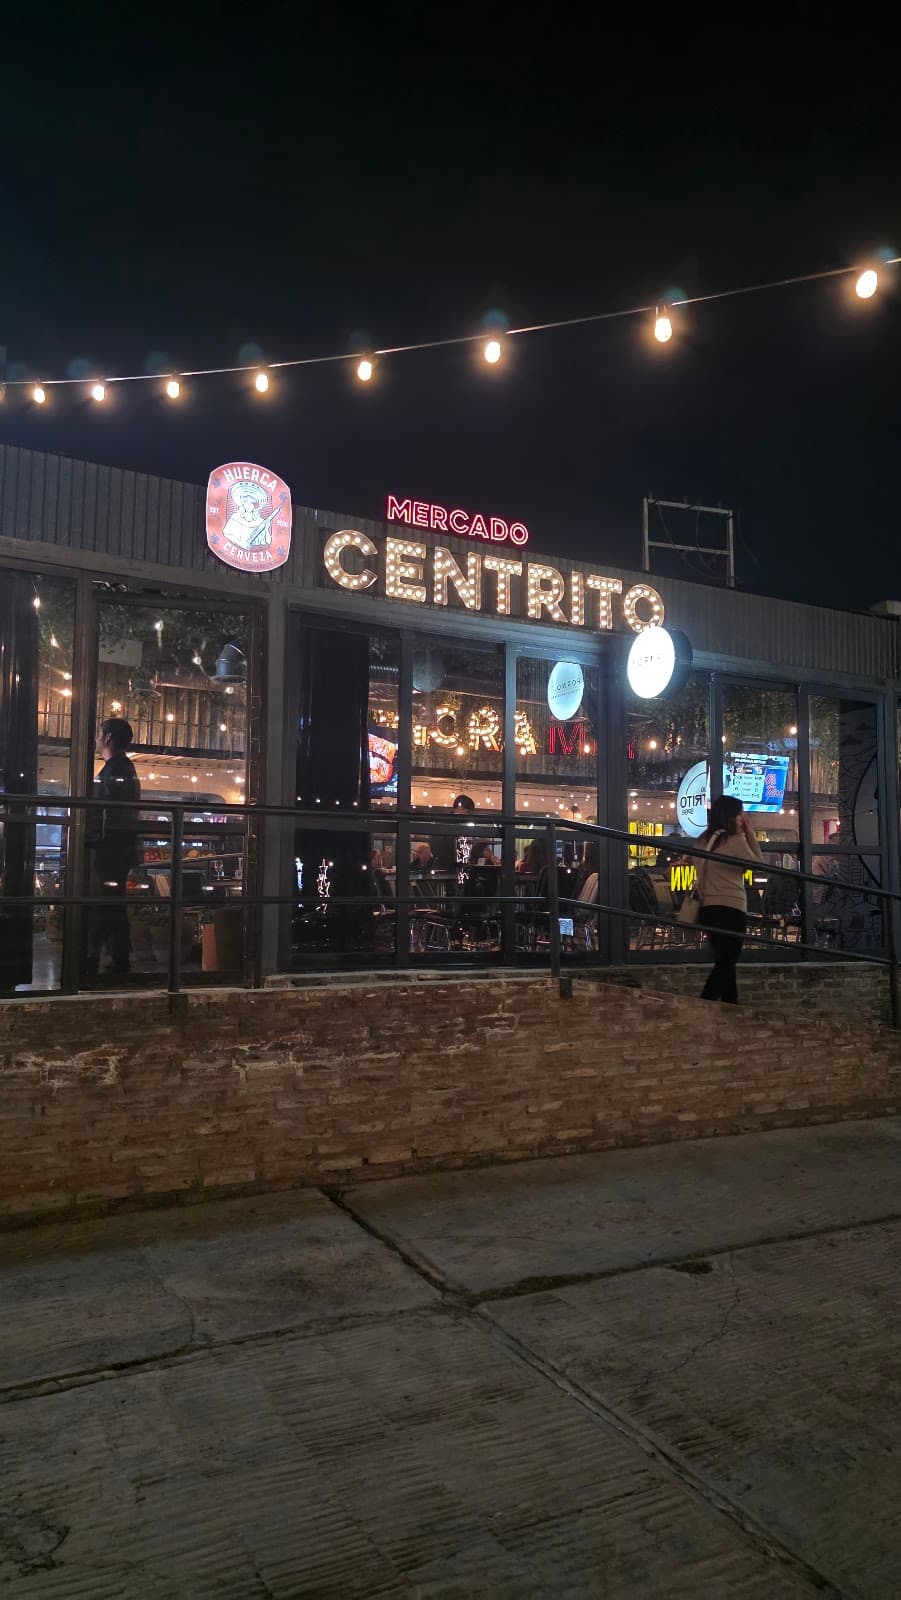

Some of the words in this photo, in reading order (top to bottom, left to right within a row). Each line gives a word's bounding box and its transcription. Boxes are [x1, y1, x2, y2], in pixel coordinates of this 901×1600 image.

[223, 466, 278, 491] HUERCA
[387, 495, 529, 545] MERCADO
[223, 542, 273, 562] CERVEZA
[323, 529, 666, 633] CENTRITO
